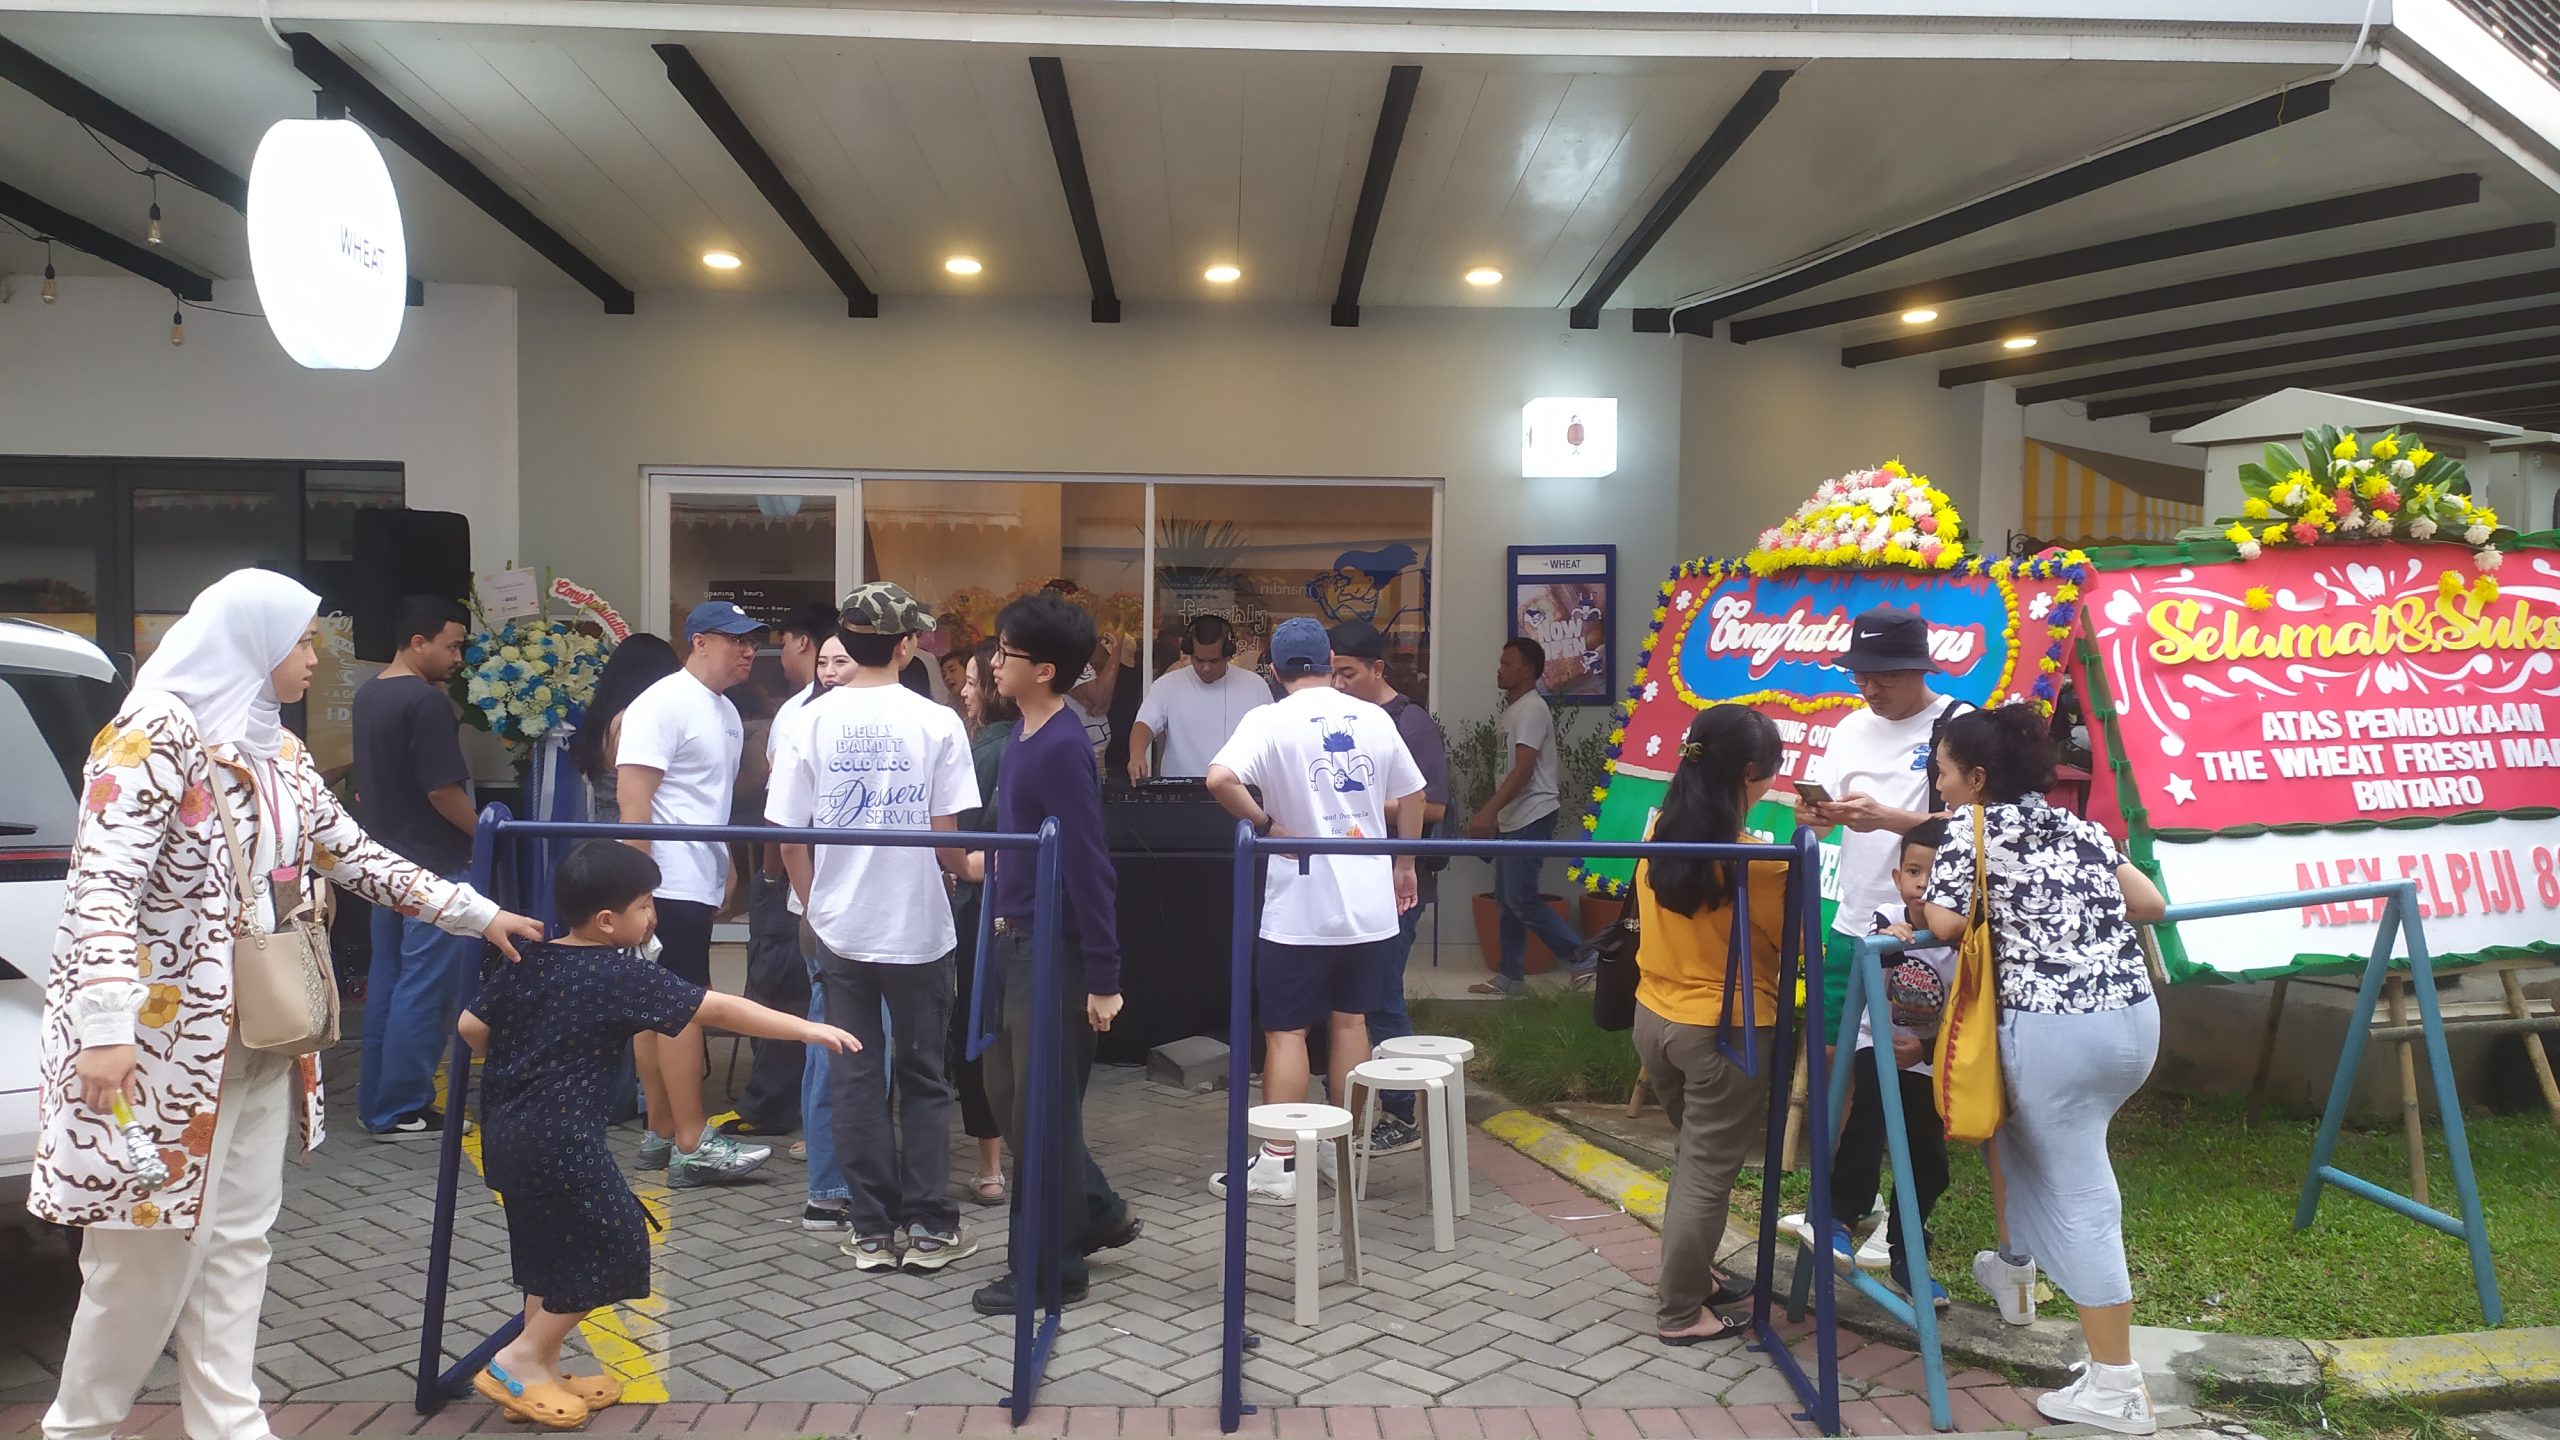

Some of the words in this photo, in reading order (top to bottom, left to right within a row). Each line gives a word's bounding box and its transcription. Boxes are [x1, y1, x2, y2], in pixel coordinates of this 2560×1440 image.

[340, 224, 386, 275] WHEAT
[1550, 559, 1581, 569] WHEAT
[704, 591, 735, 599] opening
[743, 589, 764, 597] hours
[1537, 619, 1582, 642] NOW
[842, 724, 893, 739] BELLY
[2261, 707, 2343, 742] ATAS
[2345, 702, 2545, 741] PEMBUKAAN
[836, 738, 903, 753] BANDIT
[829, 757, 873, 772] COLD
[876, 756, 911, 772] MOO
[2196, 751, 2268, 782] THE
[2270, 745, 2385, 778] WHEAT
[2393, 739, 2498, 774] FRESH
[816, 776, 926, 828] Dessert
[2352, 775, 2484, 811] BINTARO
[866, 810, 931, 824] SERVICE
[2397, 849, 2526, 919] ELPIJI
